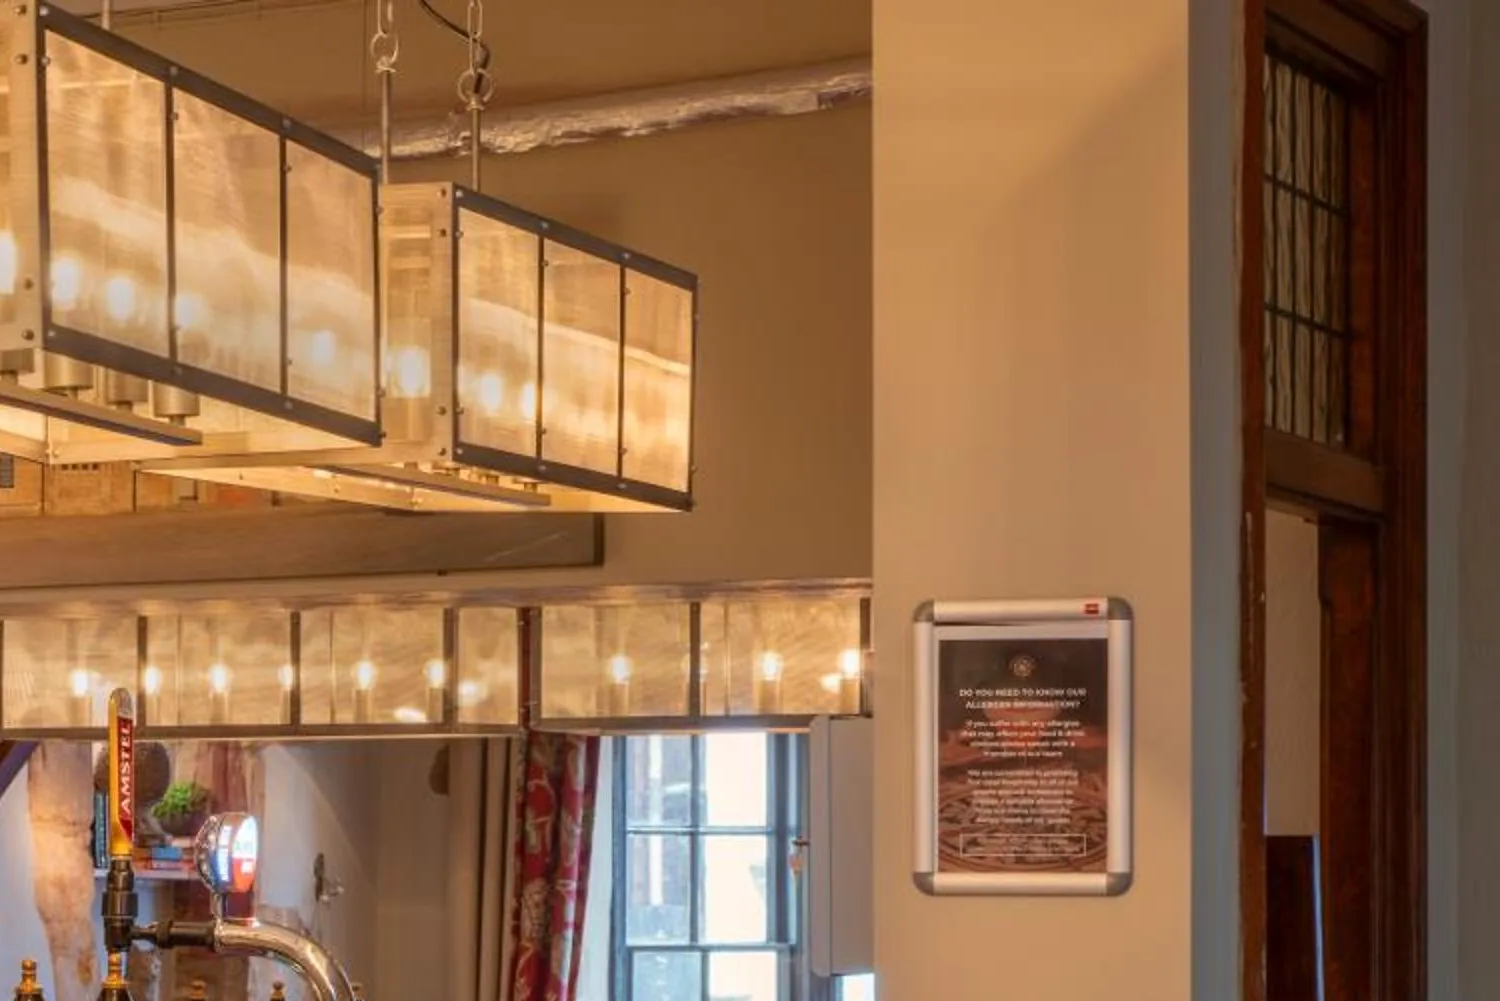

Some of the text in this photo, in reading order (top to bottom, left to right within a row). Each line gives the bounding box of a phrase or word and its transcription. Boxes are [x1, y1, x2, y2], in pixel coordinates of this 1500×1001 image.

[959, 688, 973, 697] DO
[975, 688, 994, 697] YOU
[995, 688, 1020, 697] NEED
[120, 723, 132, 816] AMSTEL
